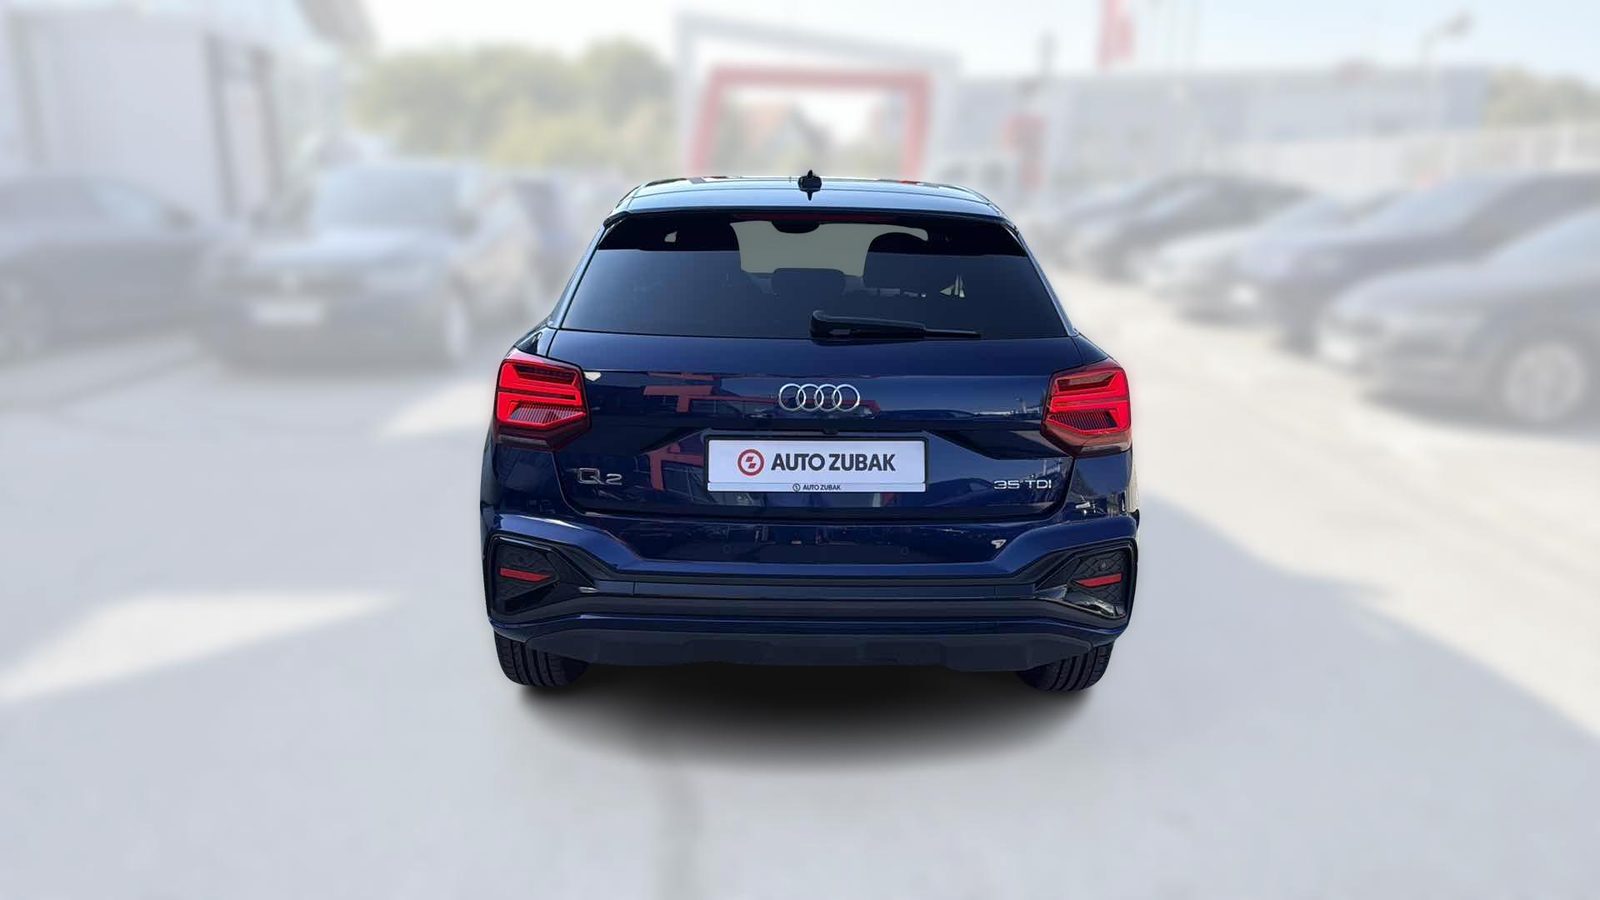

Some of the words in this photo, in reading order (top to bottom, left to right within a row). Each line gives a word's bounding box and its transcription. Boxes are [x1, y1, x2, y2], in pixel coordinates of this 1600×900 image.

[771, 453, 825, 471] AUTO
[828, 453, 896, 471] ZUBAK
[993, 480, 1020, 490] 35
[1025, 479, 1052, 489] TDI
